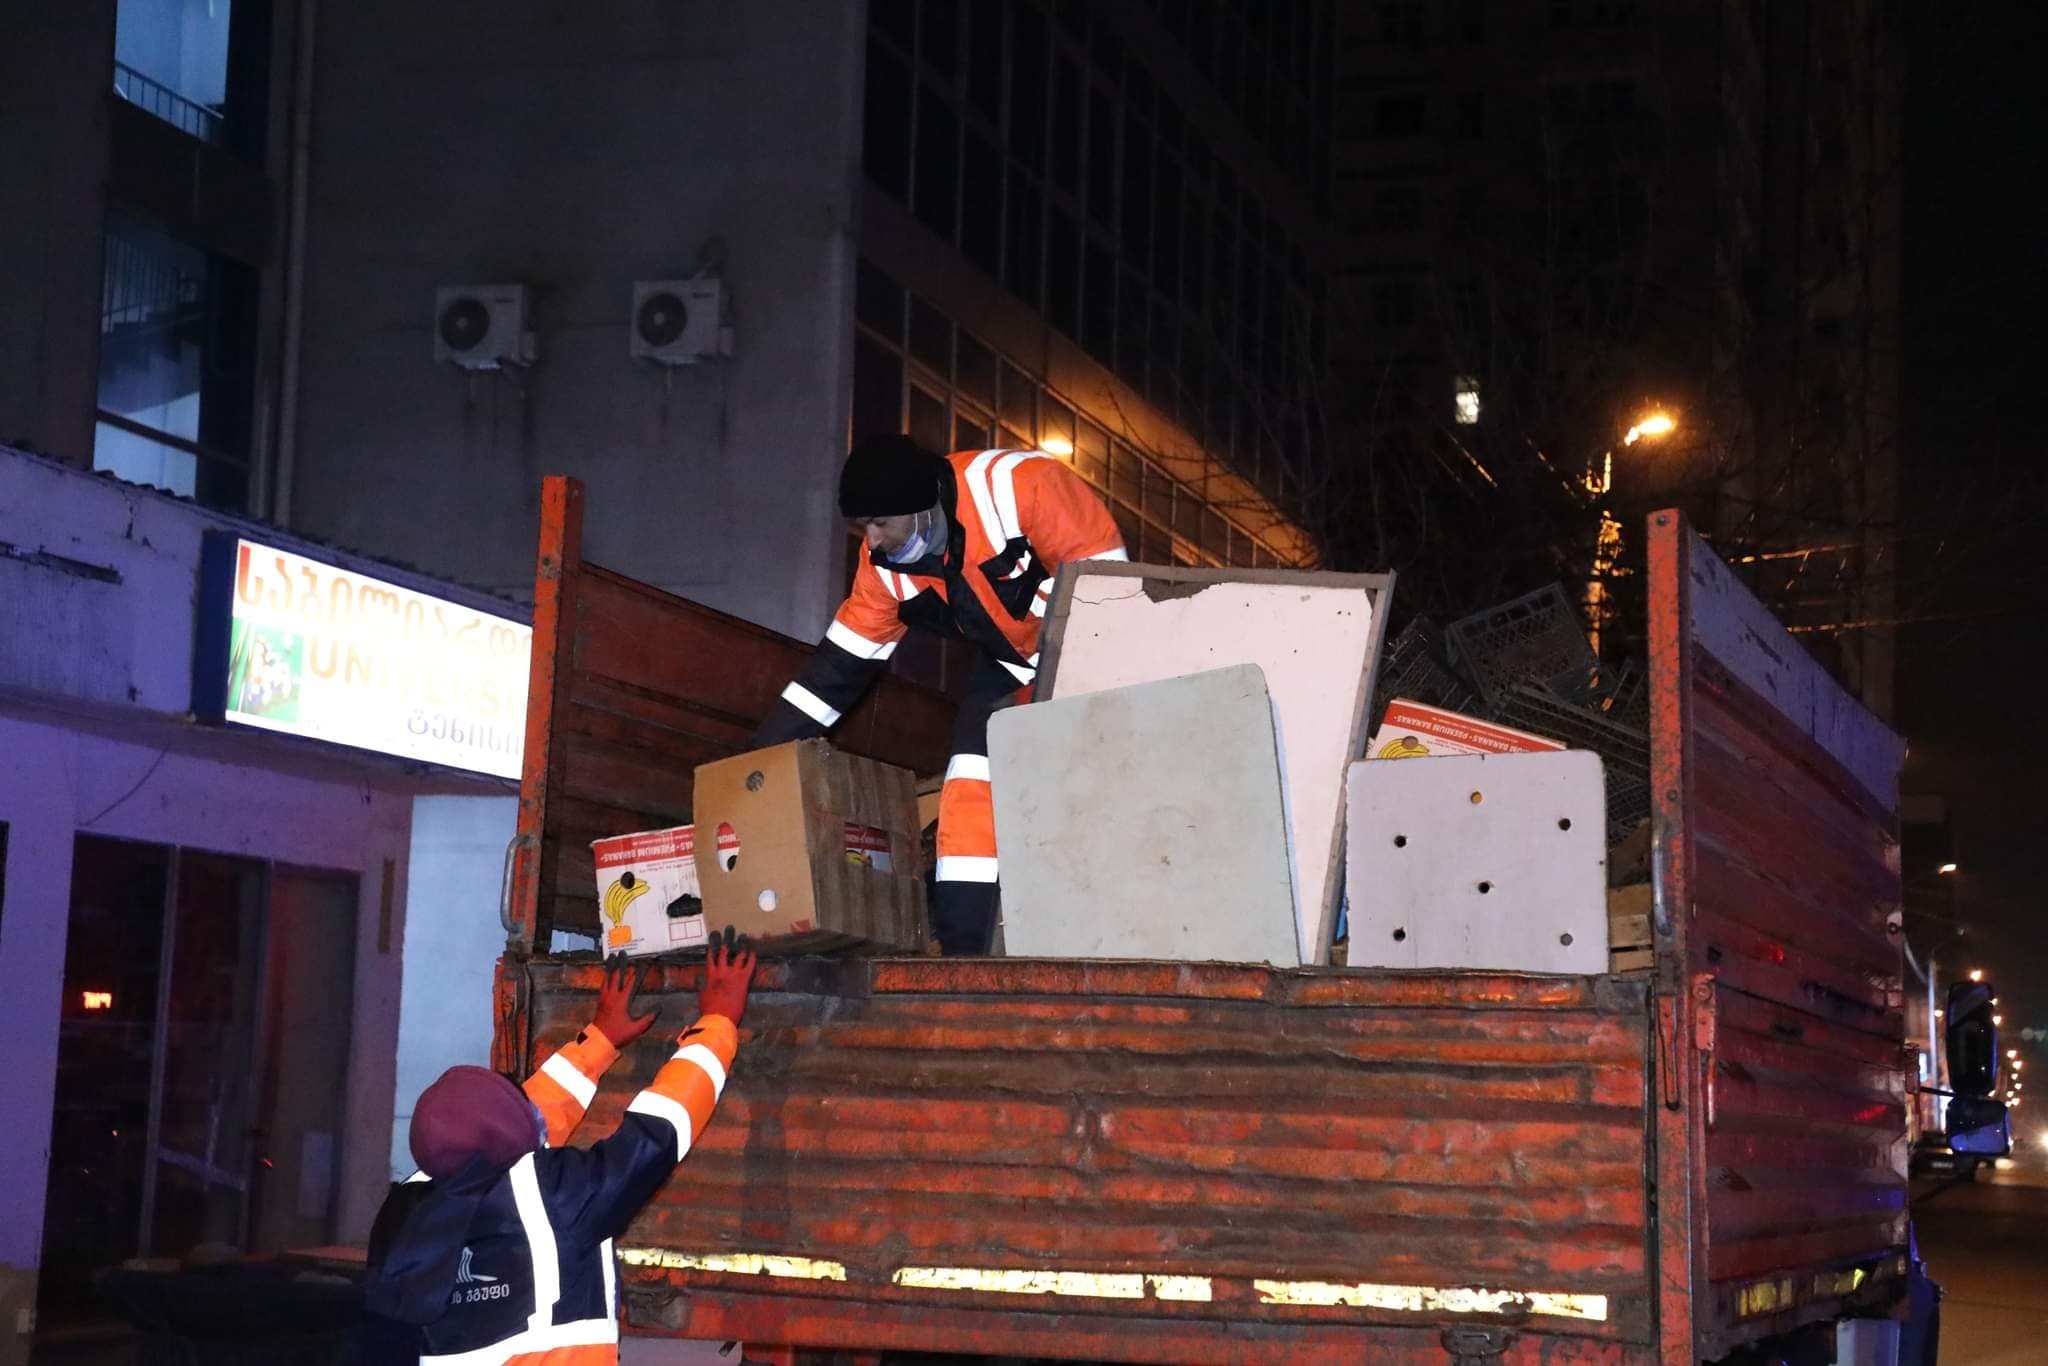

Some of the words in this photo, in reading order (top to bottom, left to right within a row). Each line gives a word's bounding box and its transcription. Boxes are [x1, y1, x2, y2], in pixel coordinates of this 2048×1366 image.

[1397, 715, 1432, 730] BANANAS
[1432, 721, 1469, 739] PREMIUM
[1471, 735, 1510, 752] BANANAS
[603, 849, 636, 862] BANANAS
[637, 842, 676, 857] PREMIUM
[466, 1284, 510, 1302] ჯგუფი
